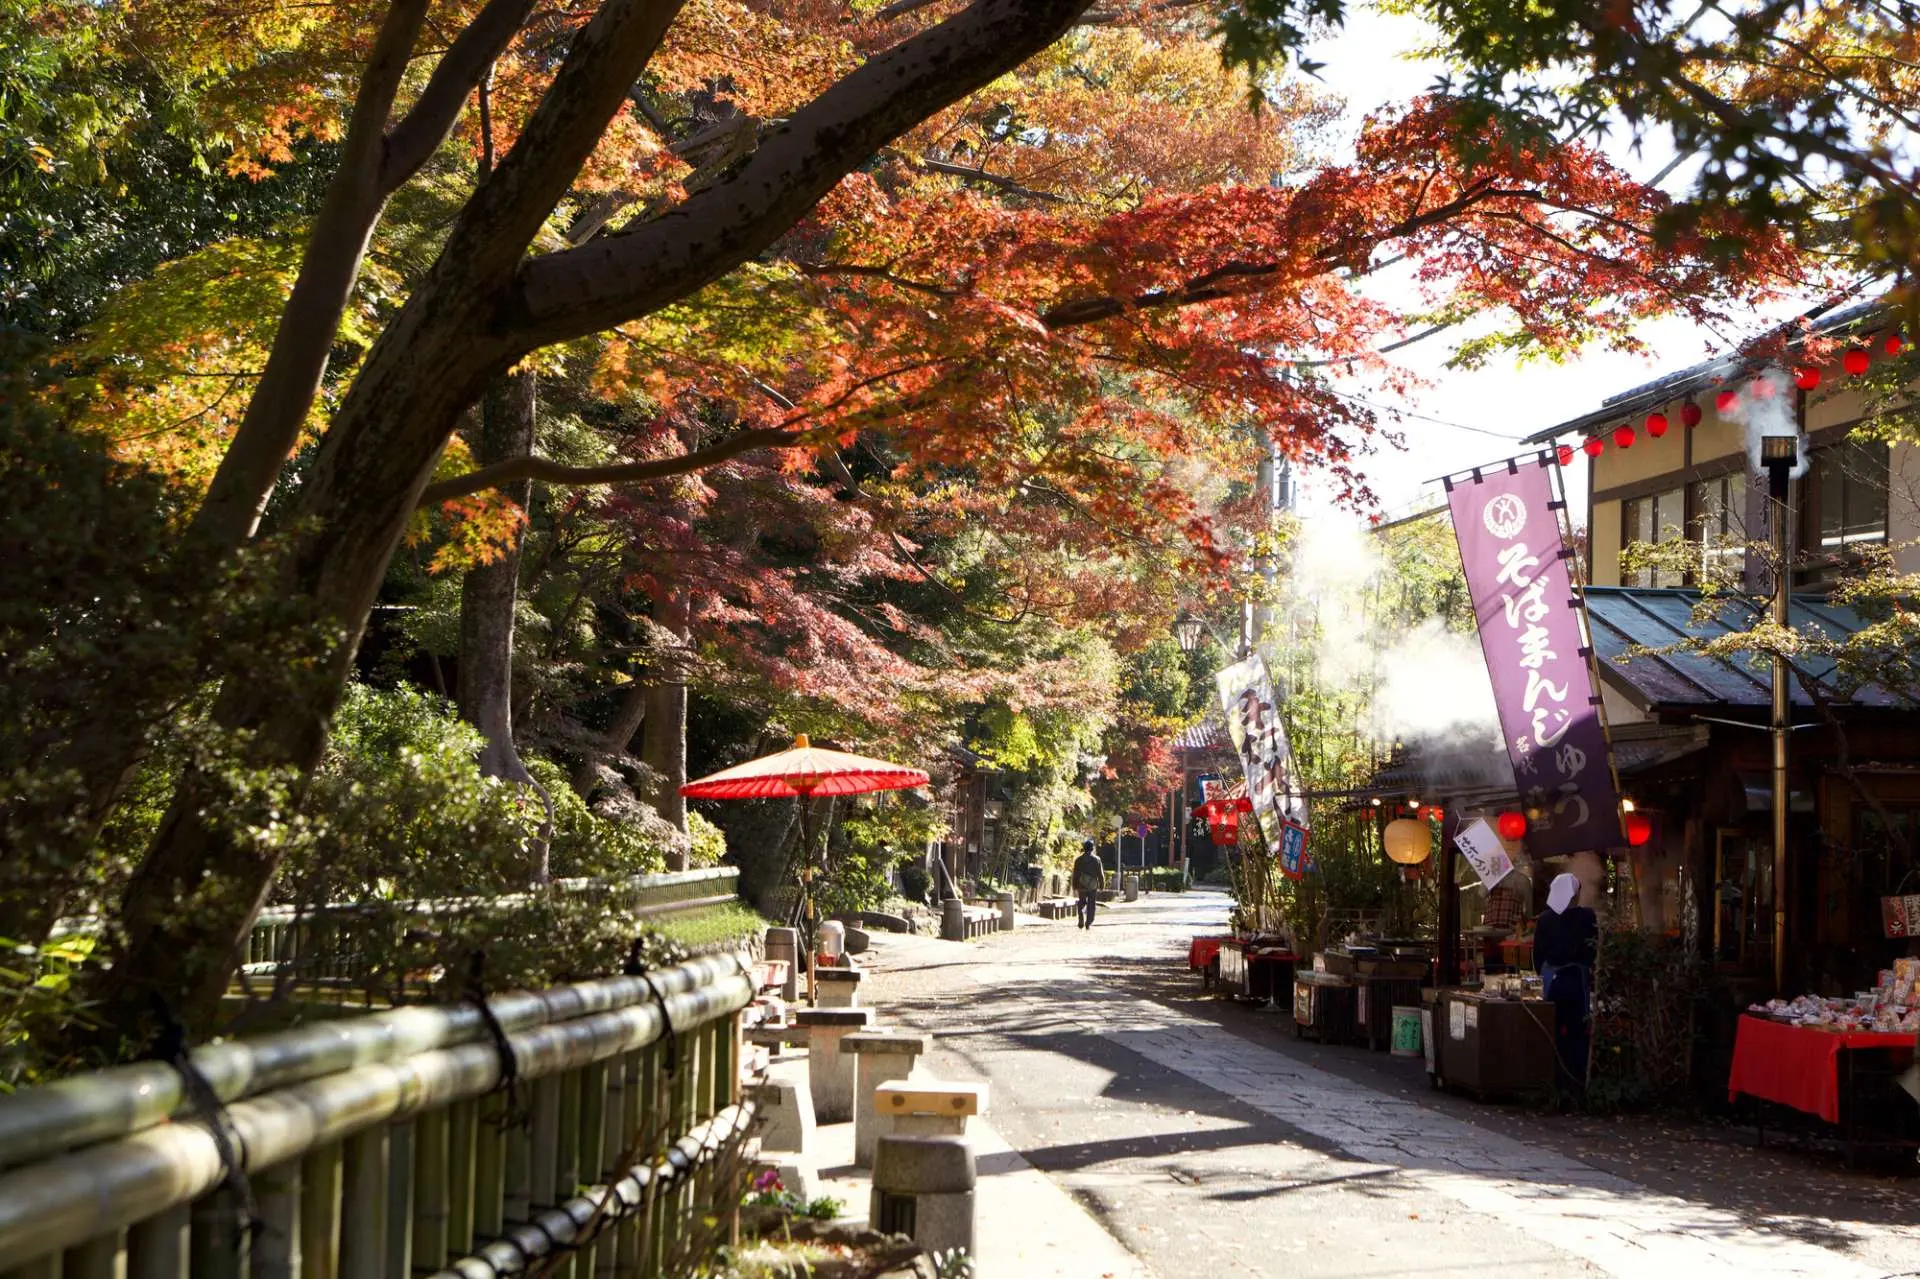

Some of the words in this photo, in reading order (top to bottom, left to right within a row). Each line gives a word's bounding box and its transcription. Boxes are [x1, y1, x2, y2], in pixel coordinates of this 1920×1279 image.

[1496, 542, 1589, 829] そばまんじゅう
